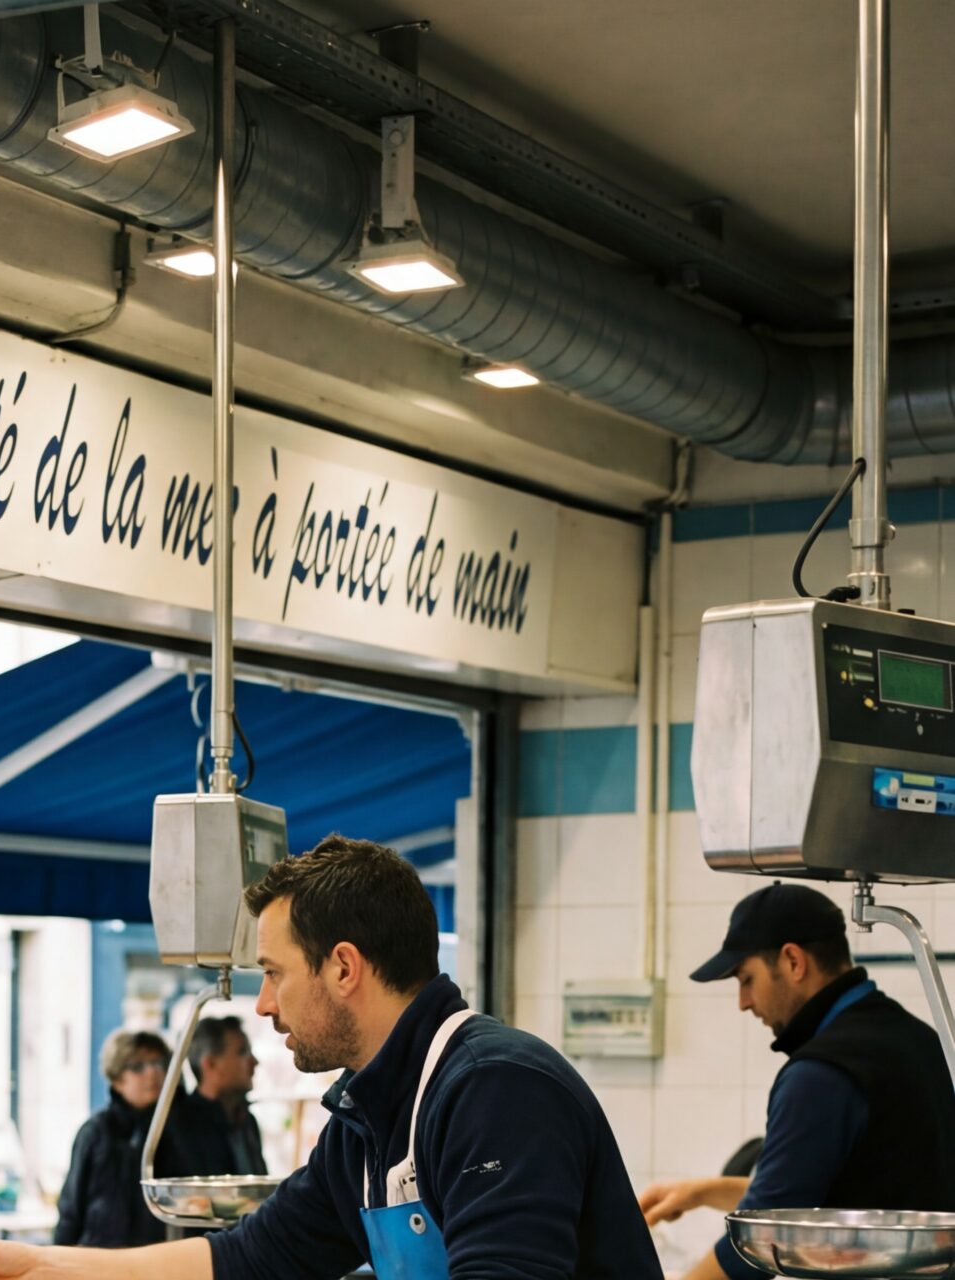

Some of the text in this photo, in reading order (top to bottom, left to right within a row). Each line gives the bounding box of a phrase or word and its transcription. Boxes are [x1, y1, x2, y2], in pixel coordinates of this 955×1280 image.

[34, 383, 88, 536] de
[102, 398, 147, 549] la
[252, 446, 278, 580] à
[281, 480, 397, 622] portée
[405, 489, 446, 617] de
[452, 529, 531, 635] main
